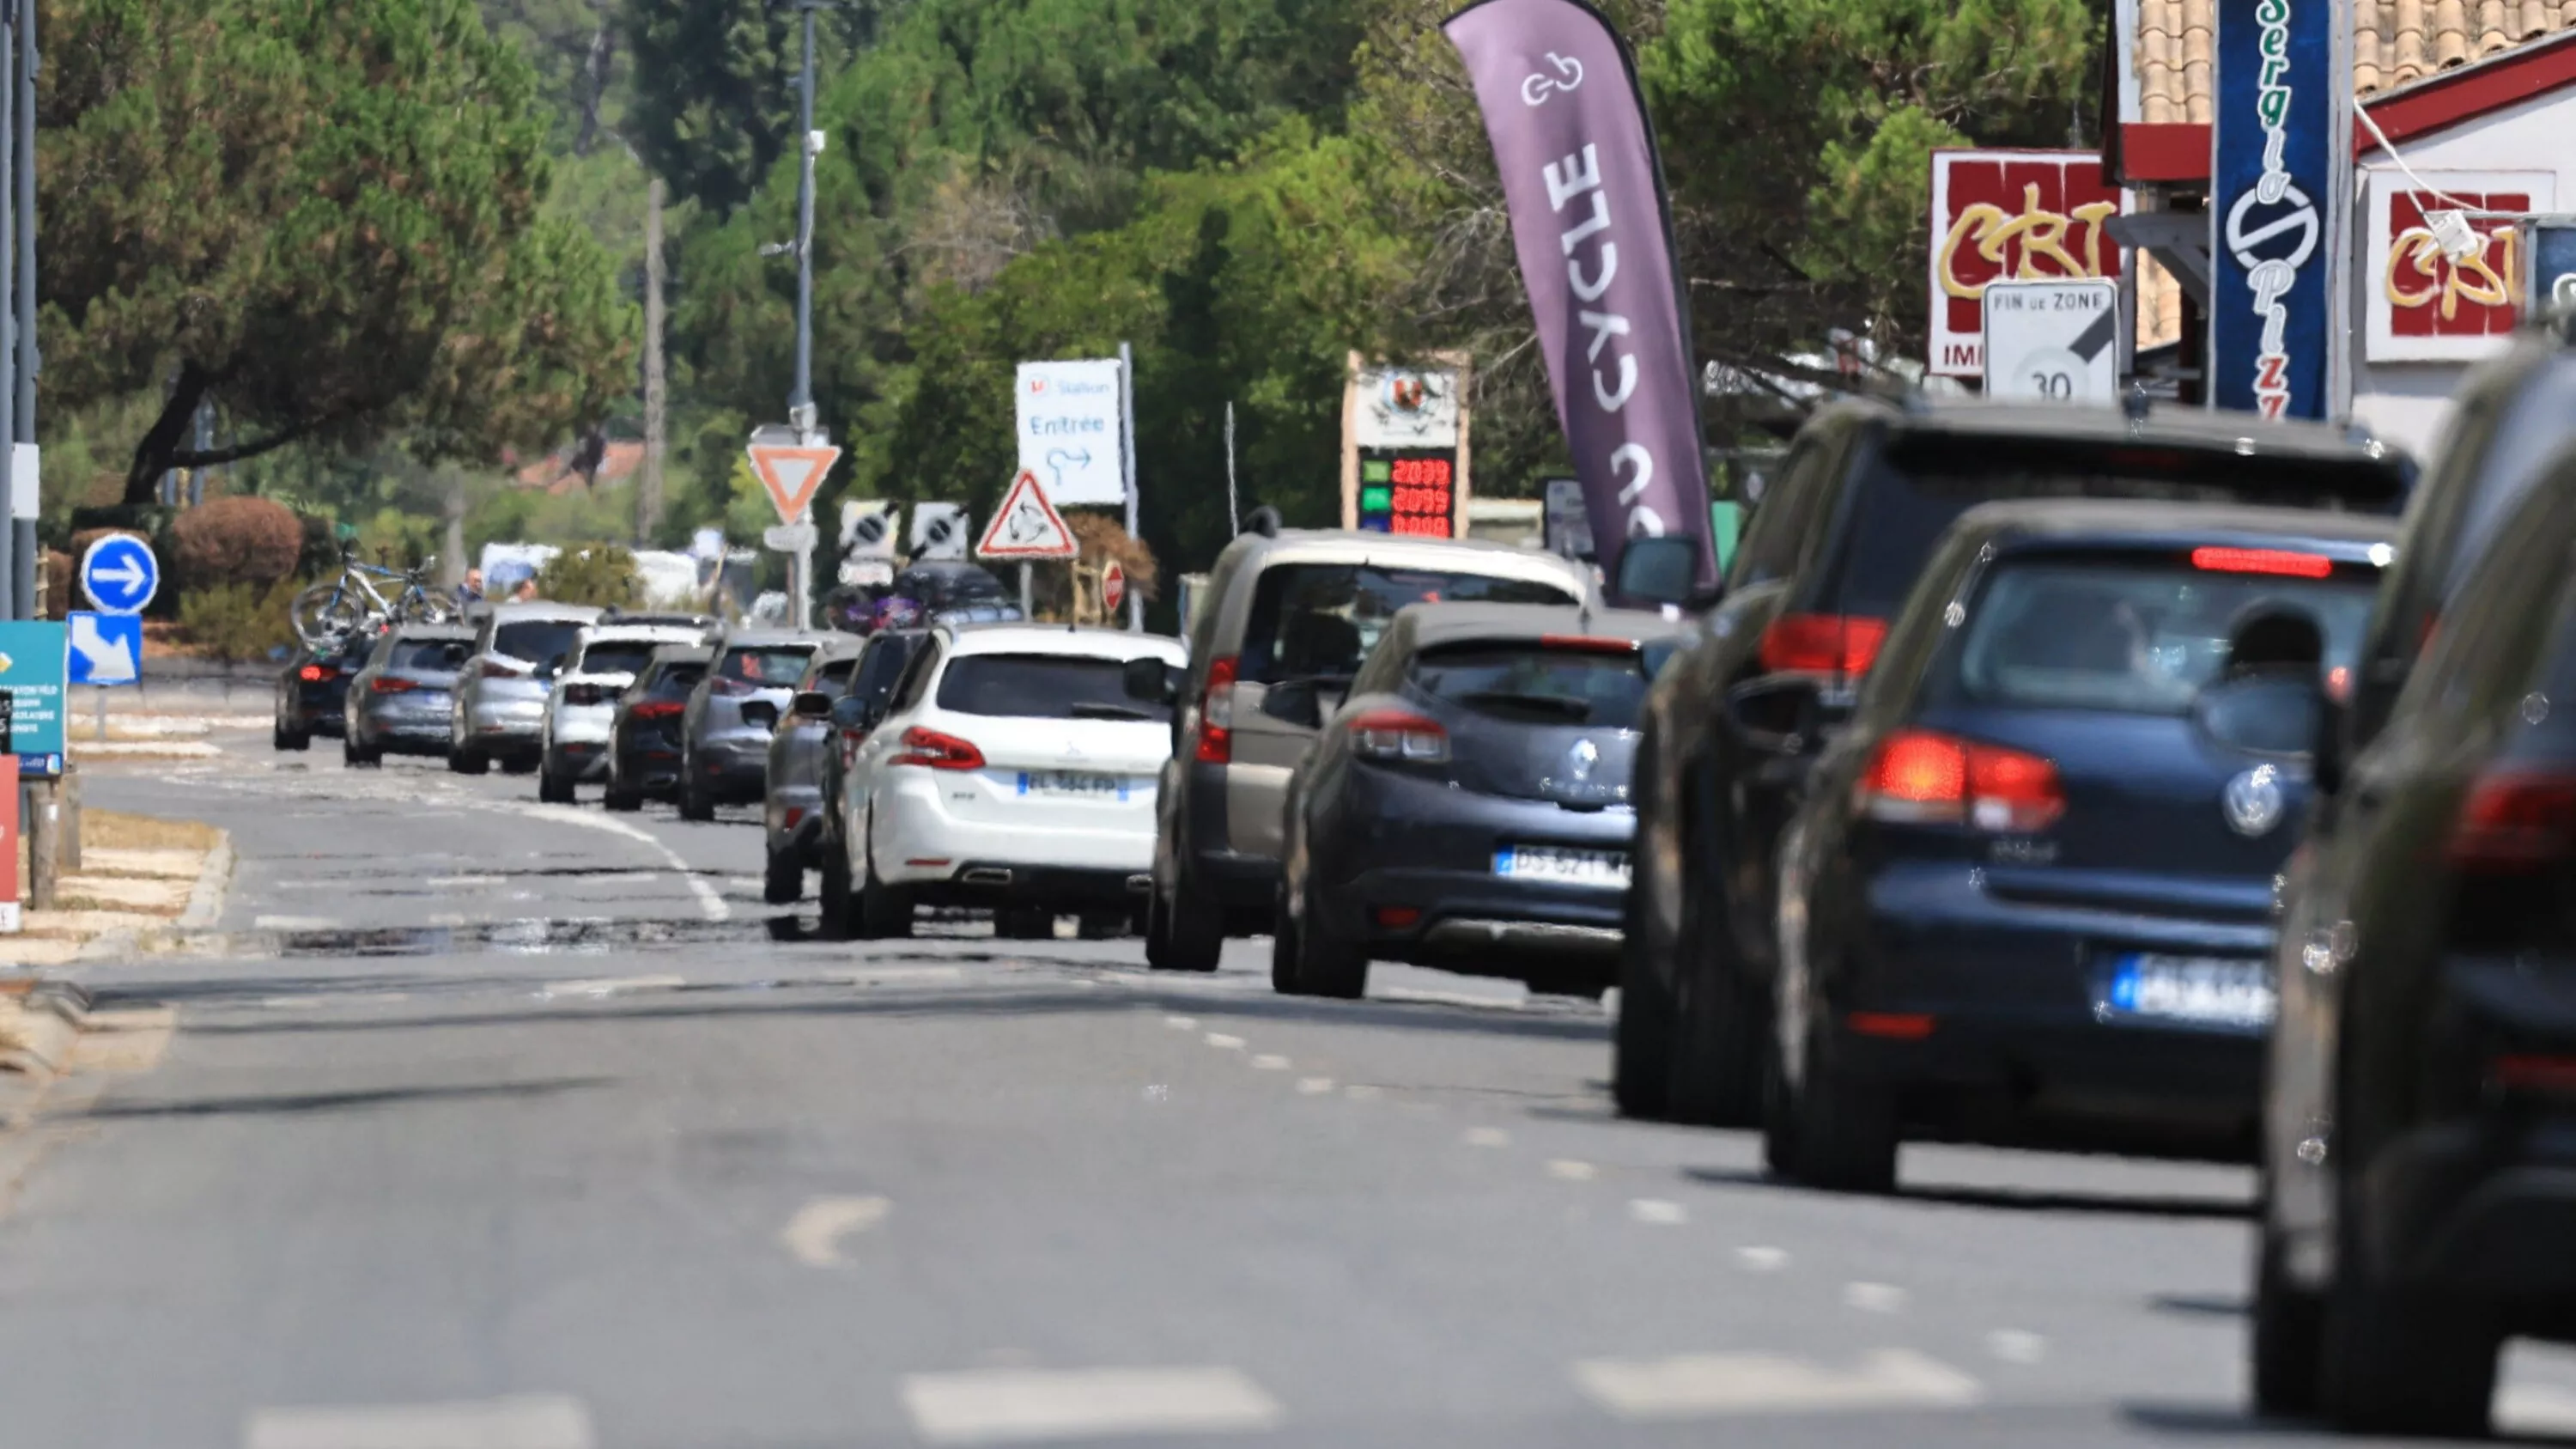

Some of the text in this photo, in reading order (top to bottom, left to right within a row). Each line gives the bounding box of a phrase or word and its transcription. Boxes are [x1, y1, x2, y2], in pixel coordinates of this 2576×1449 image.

[1542, 143, 1637, 412] CYCLE
[1994, 292, 2023, 311] FIN
[2053, 291, 2103, 311] ZONE
[1944, 345, 1983, 367] IM
[1057, 380, 1110, 396] Station
[2032, 371, 2072, 403] 30
[1030, 415, 1105, 436] Entrée
